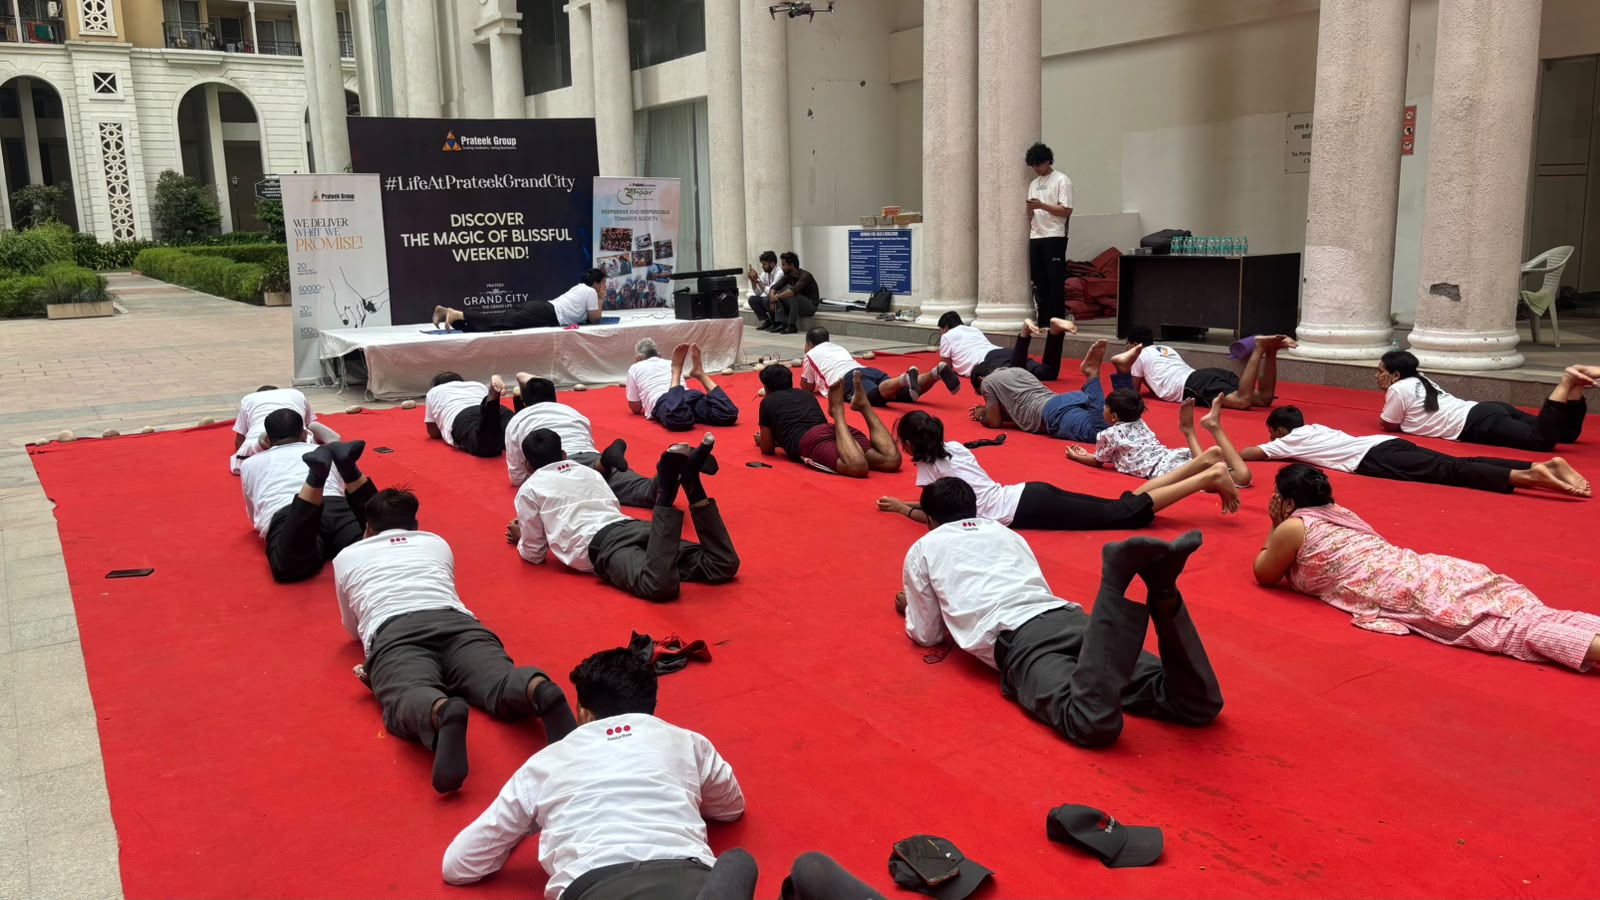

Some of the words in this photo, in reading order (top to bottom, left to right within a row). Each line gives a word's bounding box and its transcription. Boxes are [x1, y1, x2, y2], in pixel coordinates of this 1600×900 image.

[461, 136, 492, 145] Prateek
[493, 136, 517, 147] Group
[385, 174, 576, 192] #LifeAtPrateekGrandCity
[293, 218, 309, 228] WE
[311, 217, 349, 228] DELIVER
[450, 212, 524, 227] DISCOVER
[294, 228, 321, 237] WHAT
[325, 227, 341, 236] WE
[401, 233, 431, 247] THE
[433, 231, 485, 246] MAGIC
[488, 229, 508, 244] OF
[512, 228, 573, 243] BLISSFUL
[295, 235, 364, 252] PROMISE!
[452, 246, 529, 262] WEEKEND!
[463, 294, 503, 306] GRAND
[505, 293, 529, 303] CITY
